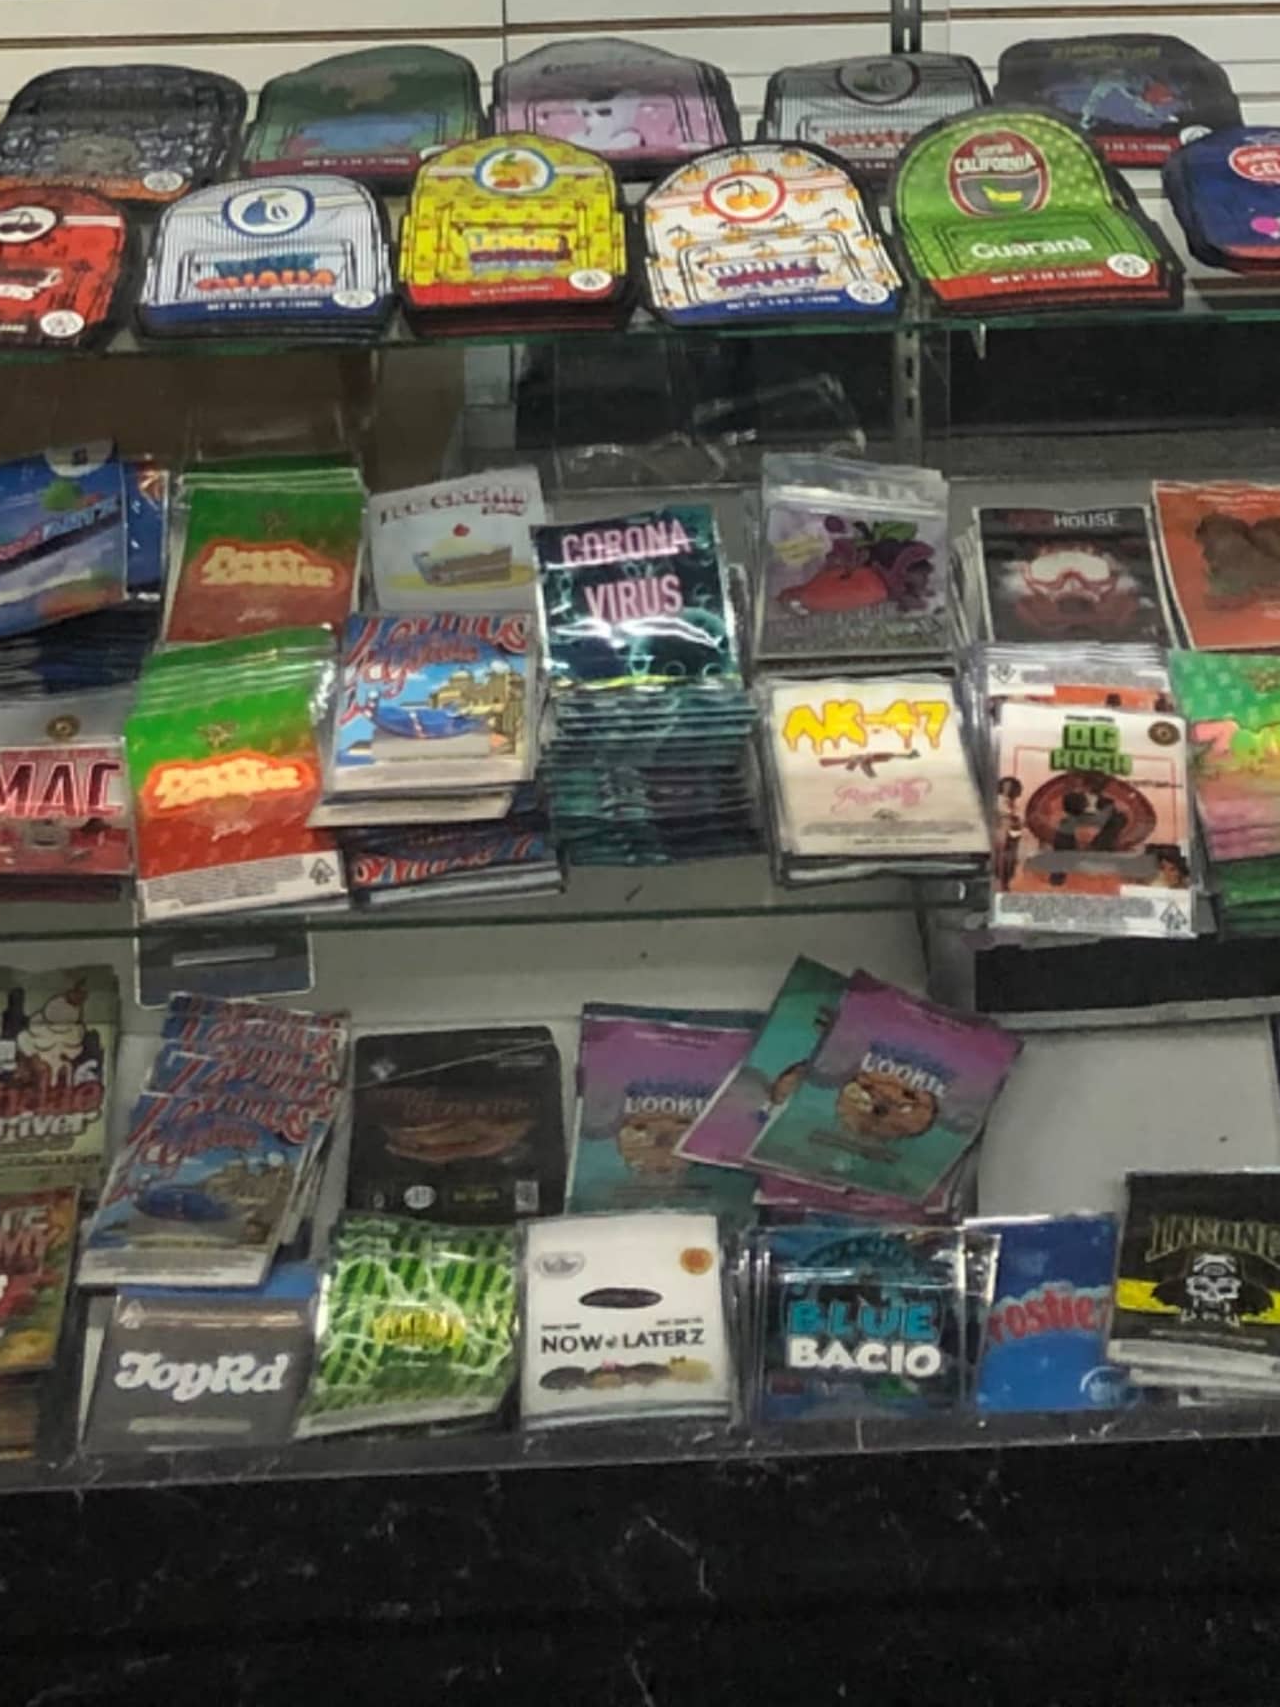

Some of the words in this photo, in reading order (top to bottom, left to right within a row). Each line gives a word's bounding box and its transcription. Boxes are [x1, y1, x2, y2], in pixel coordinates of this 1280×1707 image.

[1053, 512, 1120, 529] HOUSE
[561, 519, 693, 566] CORONA
[585, 576, 685, 623] VIRUS
[783, 700, 950, 755] AK-47
[541, 1333, 603, 1356] NOW
[621, 1326, 707, 1350] LATERZ
[787, 1301, 938, 1340] BLUE
[787, 1338, 943, 1380] BACIO
